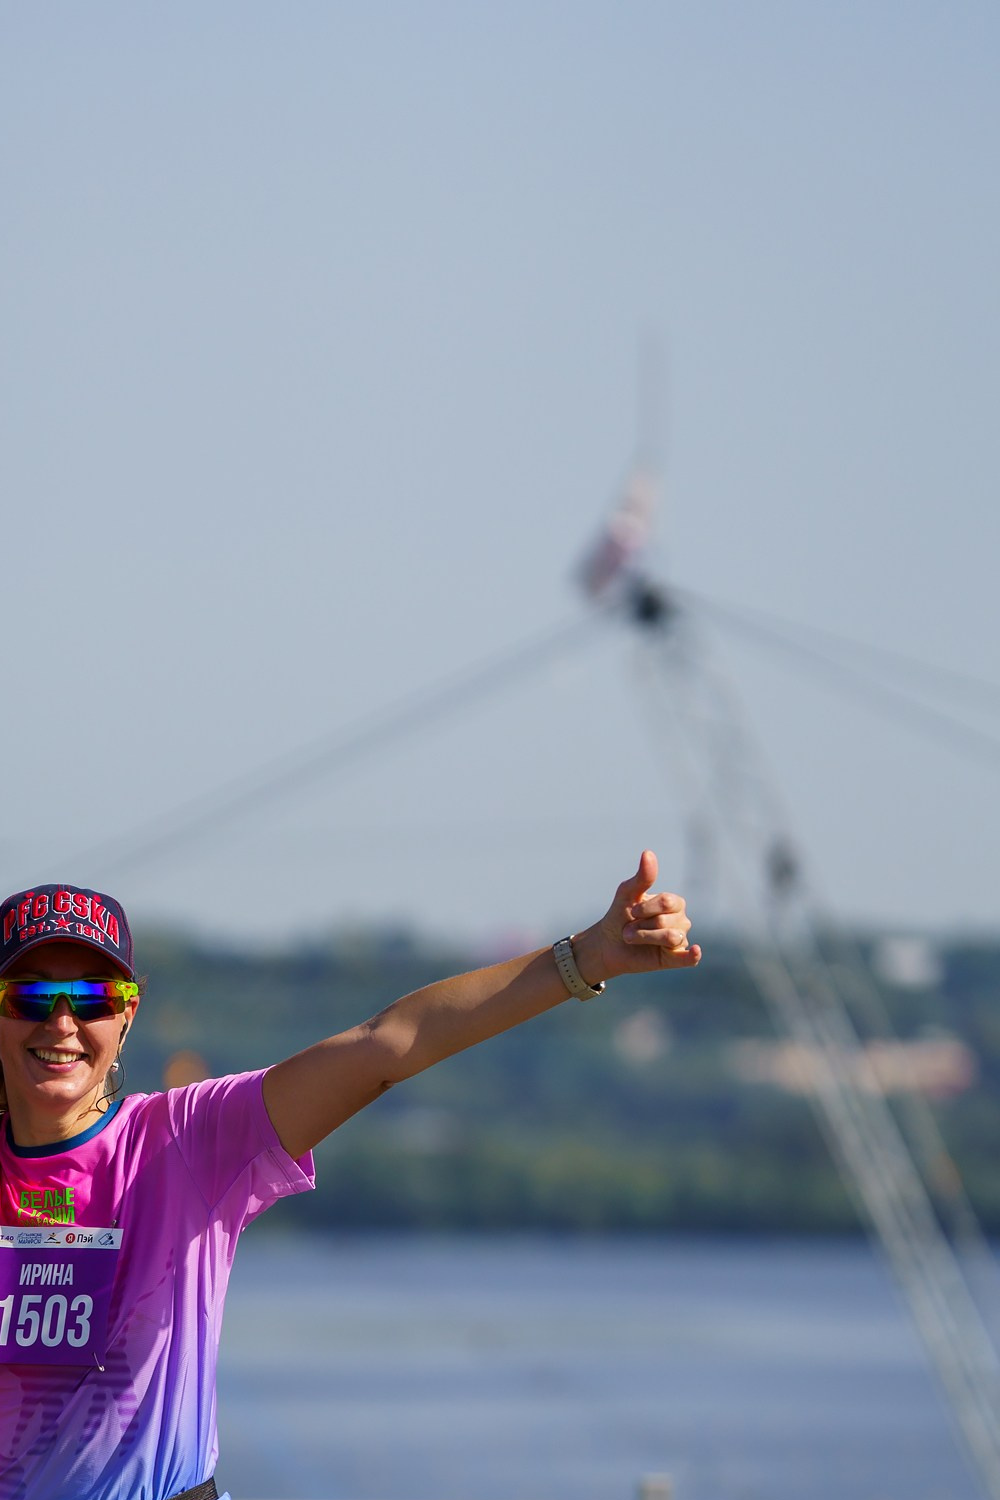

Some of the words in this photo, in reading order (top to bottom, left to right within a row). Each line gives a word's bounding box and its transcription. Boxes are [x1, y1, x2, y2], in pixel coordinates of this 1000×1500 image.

[3, 893, 49, 945] PFC
[53, 891, 120, 949] CSKA
[20, 921, 51, 942] EST.
[75, 922, 105, 945] 1911
[20, 1187, 75, 1209] БЕЛЫЕ
[76, 1233, 94, 1243] Пэй
[19, 1263, 74, 1286] ИРИНА
